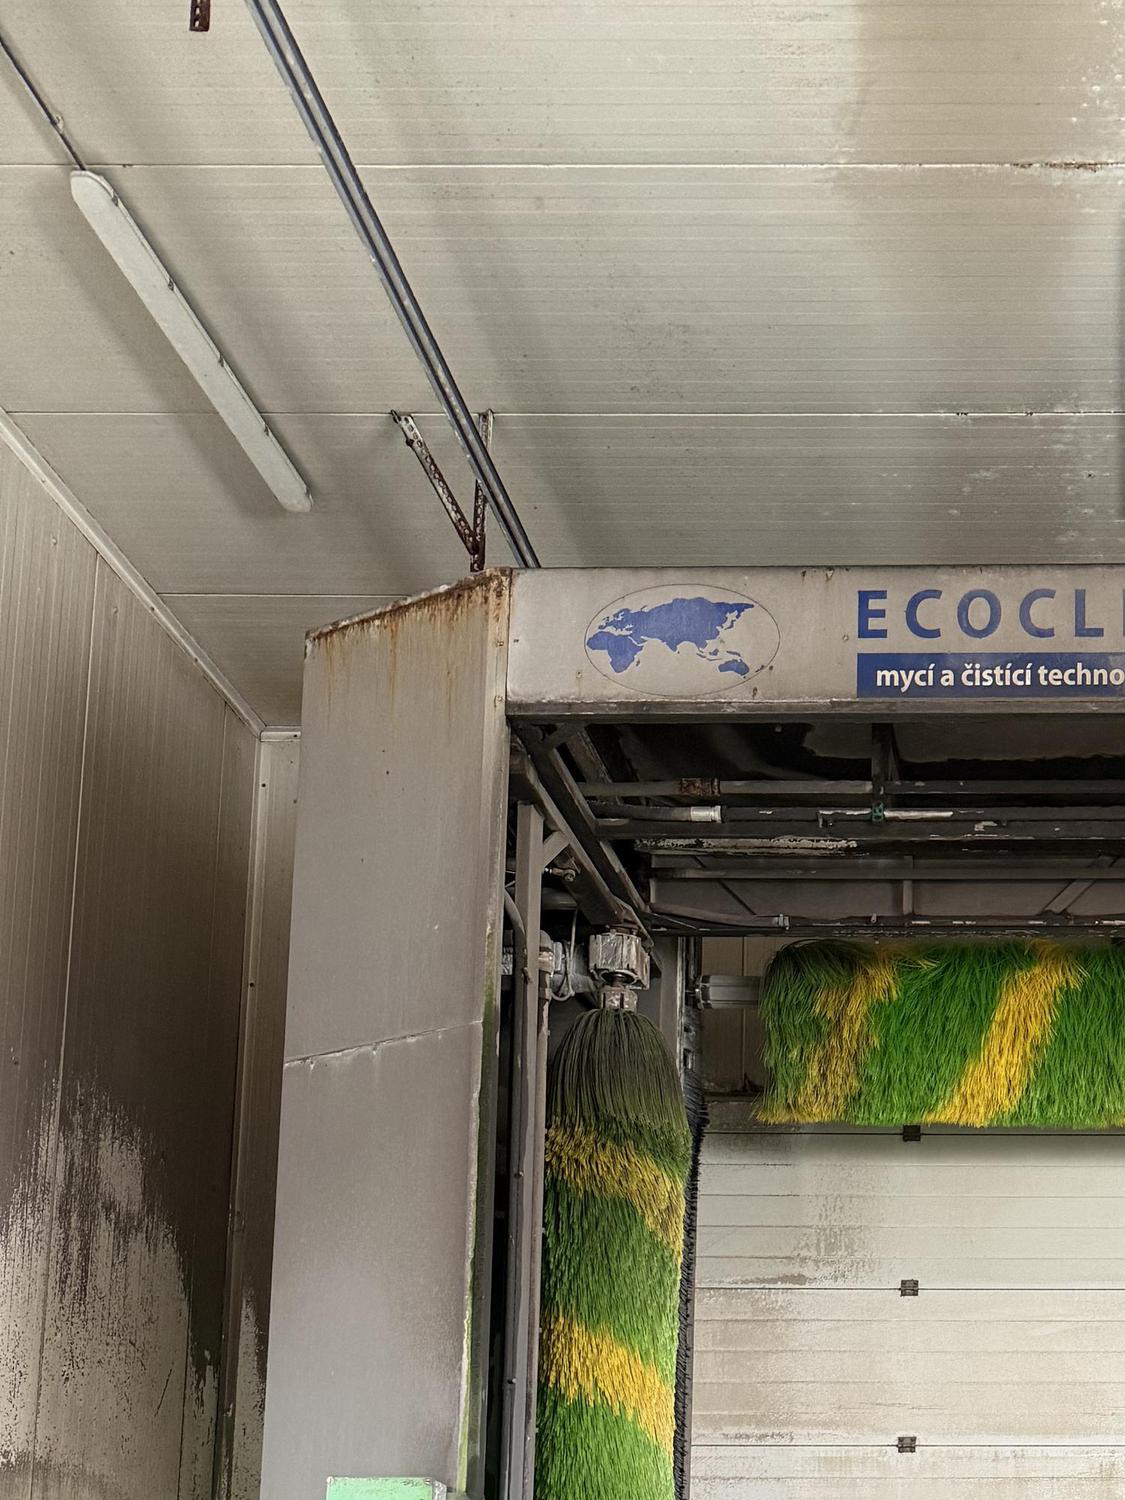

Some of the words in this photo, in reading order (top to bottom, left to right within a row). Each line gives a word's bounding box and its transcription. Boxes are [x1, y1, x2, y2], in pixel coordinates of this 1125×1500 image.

[876, 663, 934, 693] mycí
[940, 669, 955, 686] a
[961, 663, 1032, 686] čistící
